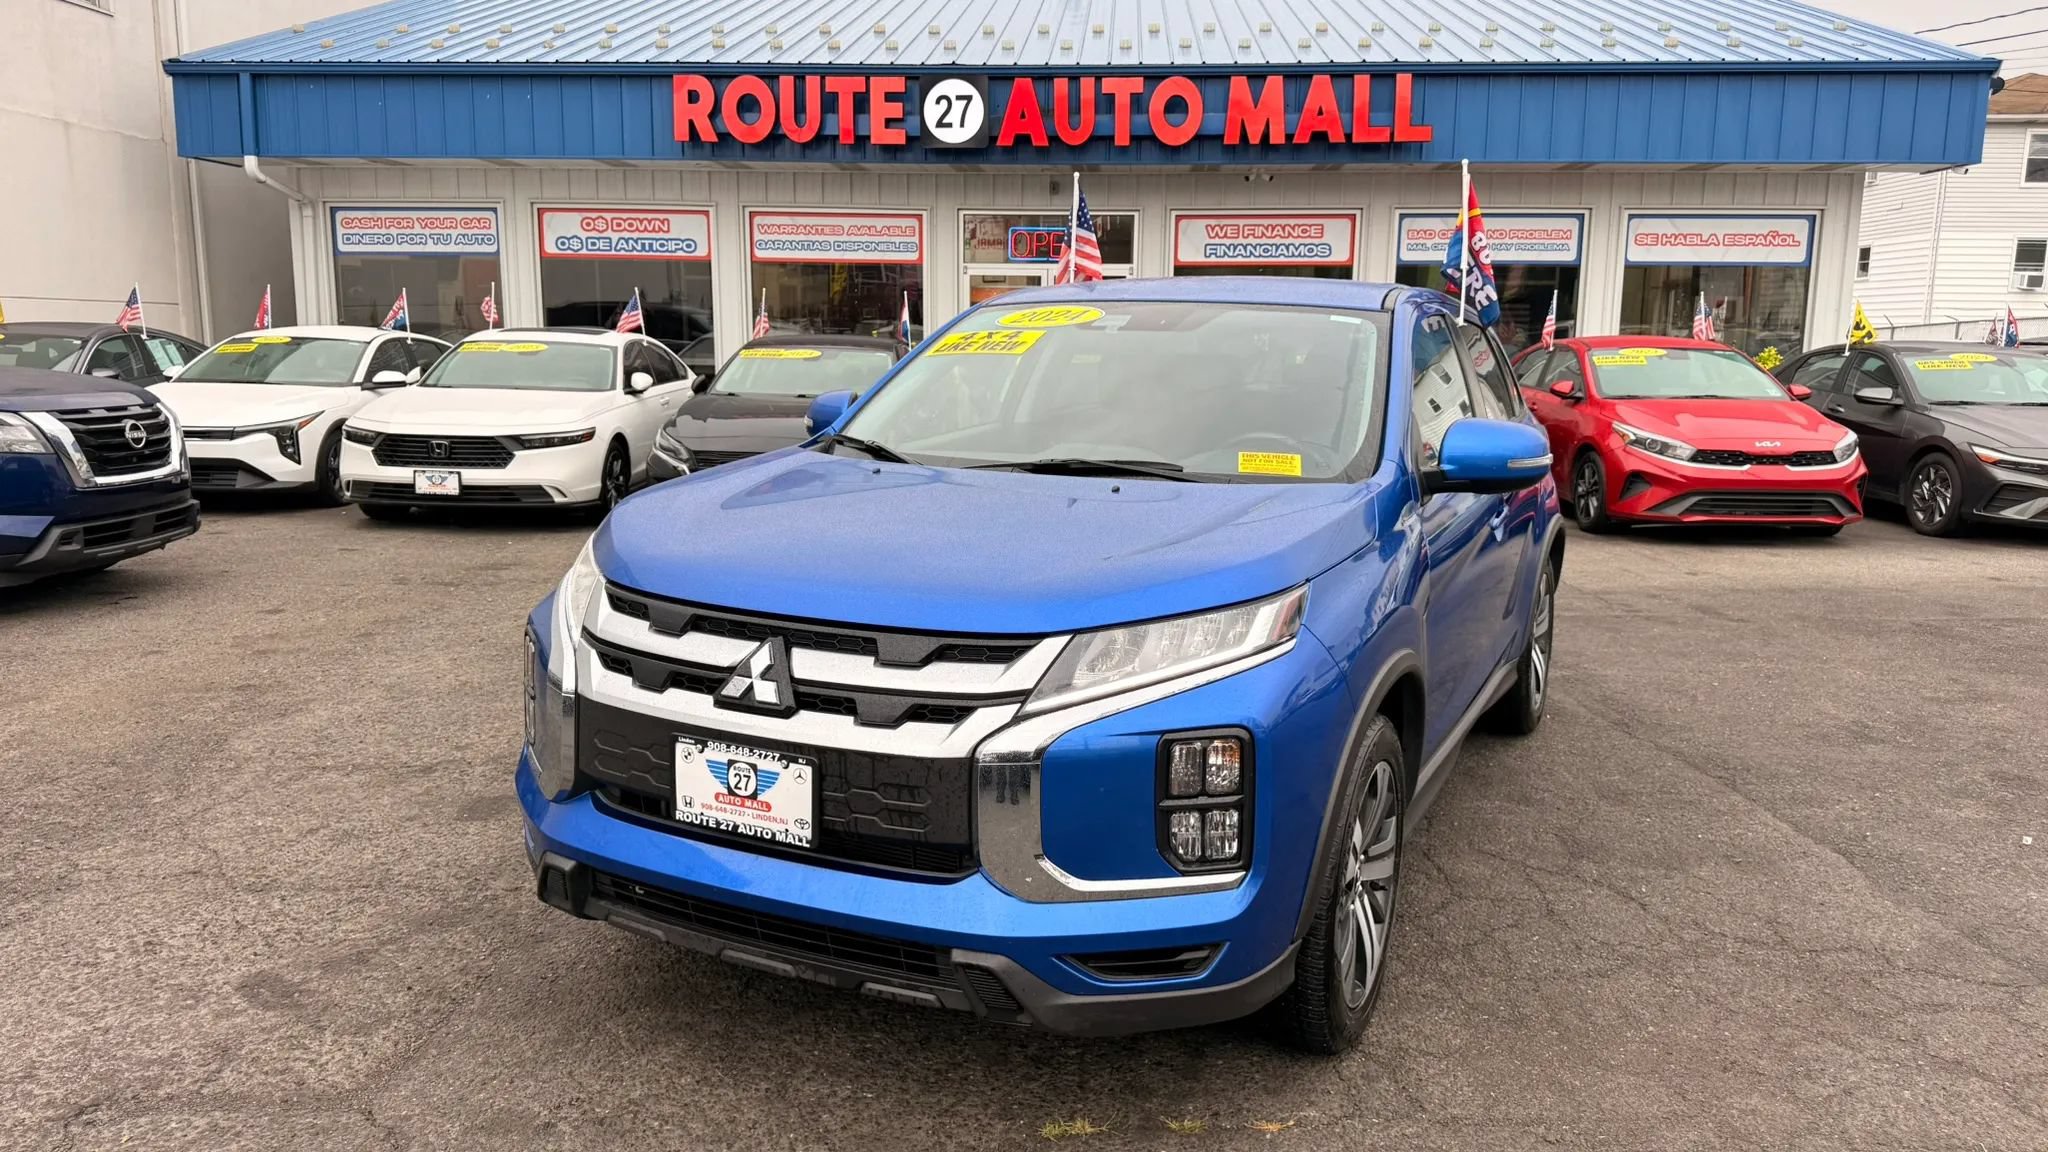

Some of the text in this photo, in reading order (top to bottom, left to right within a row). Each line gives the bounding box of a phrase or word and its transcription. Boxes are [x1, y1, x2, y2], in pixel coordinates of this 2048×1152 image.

[672, 73, 1434, 146] ROUTE 27 AUTO MALL
[341, 217, 491, 230] CASH FOR YOUR CAR
[611, 218, 670, 233] DOWN
[757, 224, 916, 237] WARRANTIES AVAILABLE
[1205, 224, 1324, 239] WE FINANCE
[1407, 229, 1437, 240] BAD
[1487, 229, 1507, 240] NO
[1508, 229, 1572, 240] PROBLEM
[1635, 230, 1800, 247] SE HABLA ESPAÑOL
[343, 233, 496, 246] DINERO POR TU AUTO
[586, 237, 612, 251] DE
[615, 237, 697, 254] ANTICIPO
[756, 240, 918, 253] GARANTIAS DISPONIBLES
[1011, 231, 1066, 258] OPE
[1492, 243, 1514, 251] HAY
[1515, 243, 1571, 251] PROBLEMA
[1204, 243, 1332, 258] FINANCIAMOS
[1010, 309, 1092, 325] 2024
[934, 341, 1025, 353] LIKE NEW
[707, 741, 781, 763] 908-648-2727
[733, 765, 752, 775] ROUTE
[733, 773, 752, 792] 27
[701, 802, 746, 817] 908-648-2727
[718, 793, 769, 812] AUTO MALL
[675, 810, 811, 848] ROUTE 27 AUTO MALL
